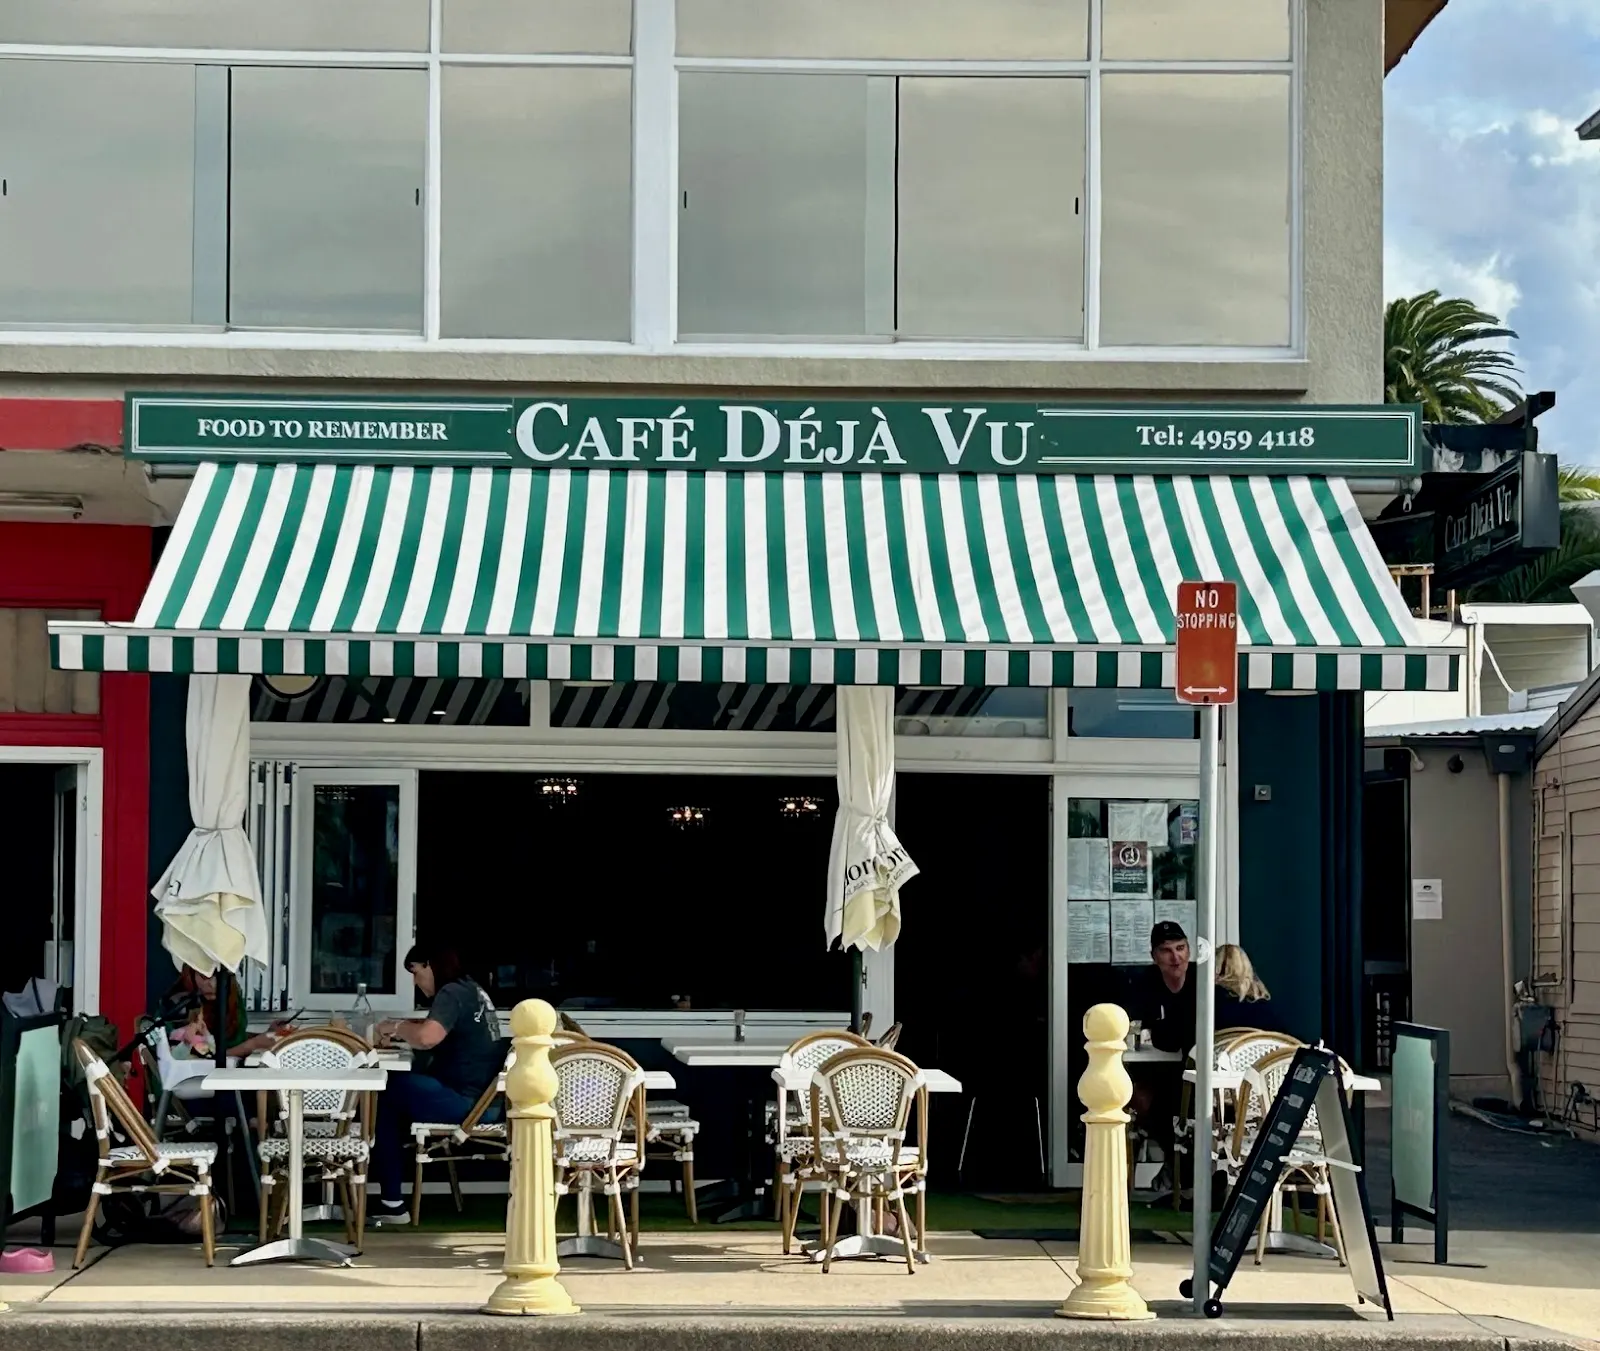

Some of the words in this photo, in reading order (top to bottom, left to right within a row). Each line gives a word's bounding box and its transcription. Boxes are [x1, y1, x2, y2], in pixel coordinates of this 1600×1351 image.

[198, 418, 265, 438] FOOD
[270, 420, 303, 439] TO
[308, 420, 448, 441] REMEMBER
[516, 402, 697, 462] CAFÉ
[718, 405, 907, 465] DÉJÀ
[921, 407, 1034, 466] VU
[1136, 425, 1184, 446] Tel:
[1190, 430, 1252, 450] 4959
[1258, 427, 1315, 450] 4118
[1195, 589, 1219, 609] NO
[1177, 612, 1235, 630] STOPPING
